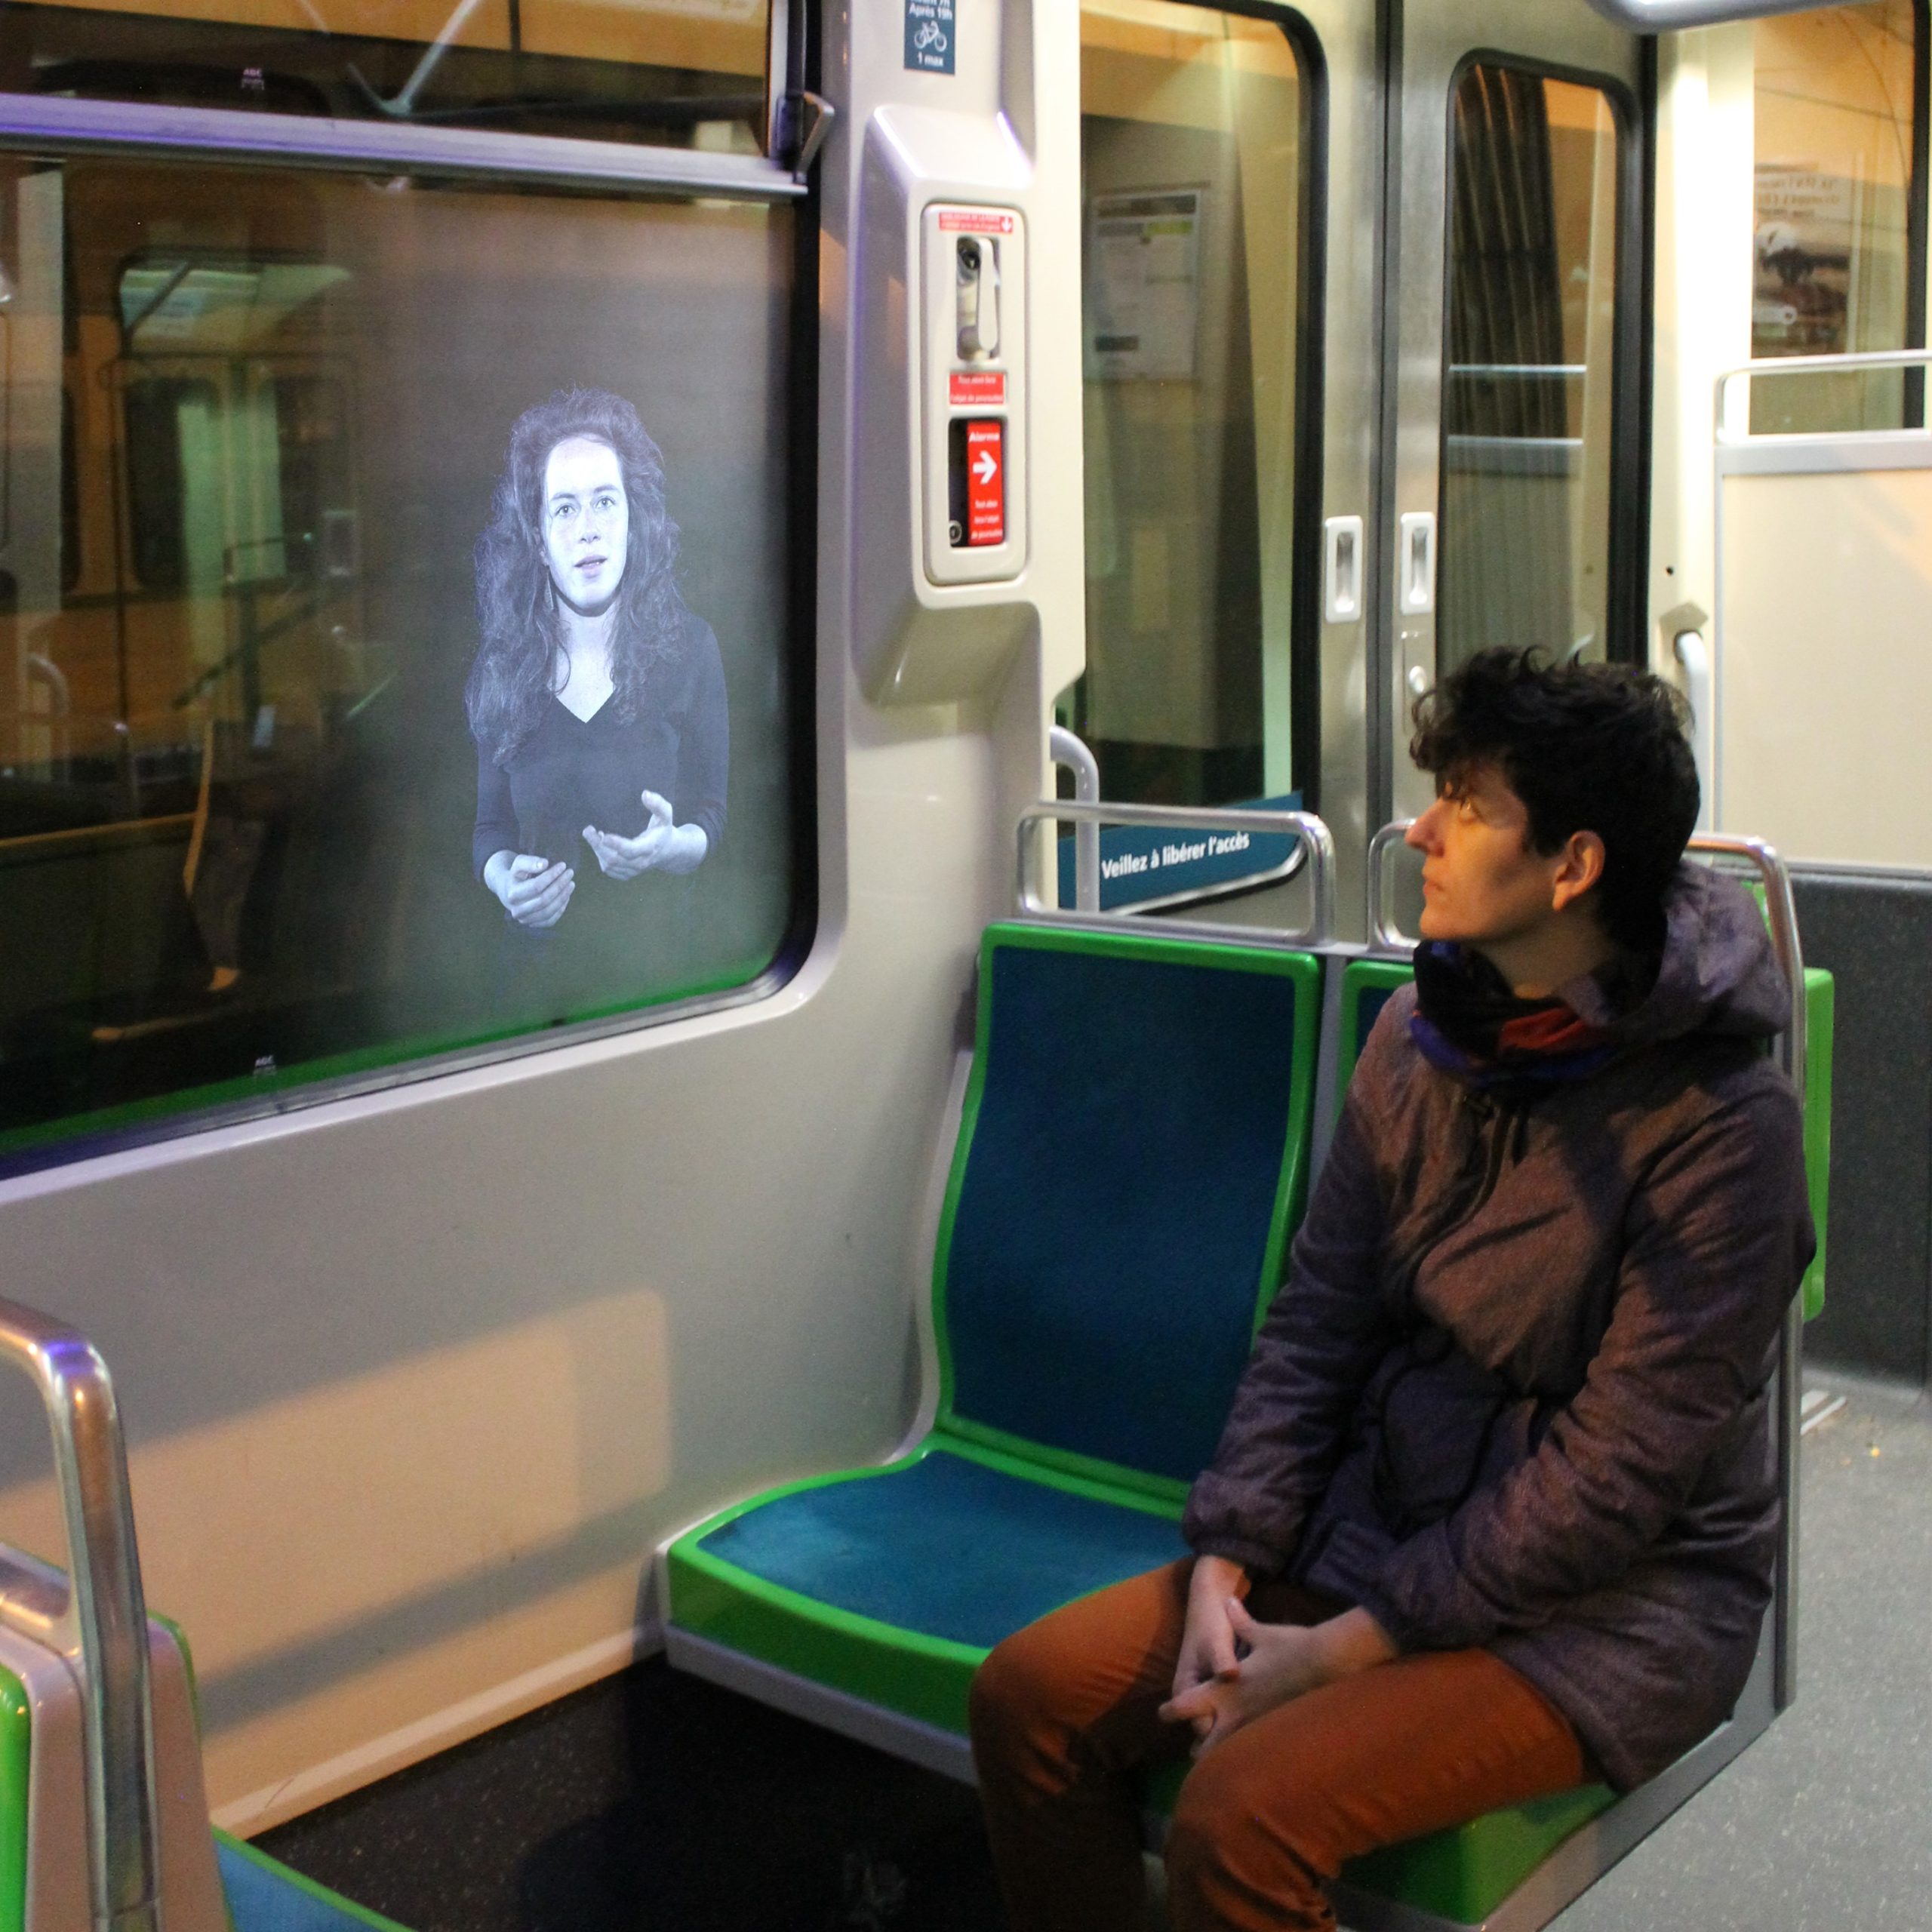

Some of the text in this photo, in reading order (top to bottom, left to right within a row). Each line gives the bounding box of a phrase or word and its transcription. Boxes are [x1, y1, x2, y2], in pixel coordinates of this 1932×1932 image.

[909, 2, 934, 18] Après
[918, 51, 943, 66] 1 max
[1101, 830, 1250, 879] Veillez à libérer l'accès
